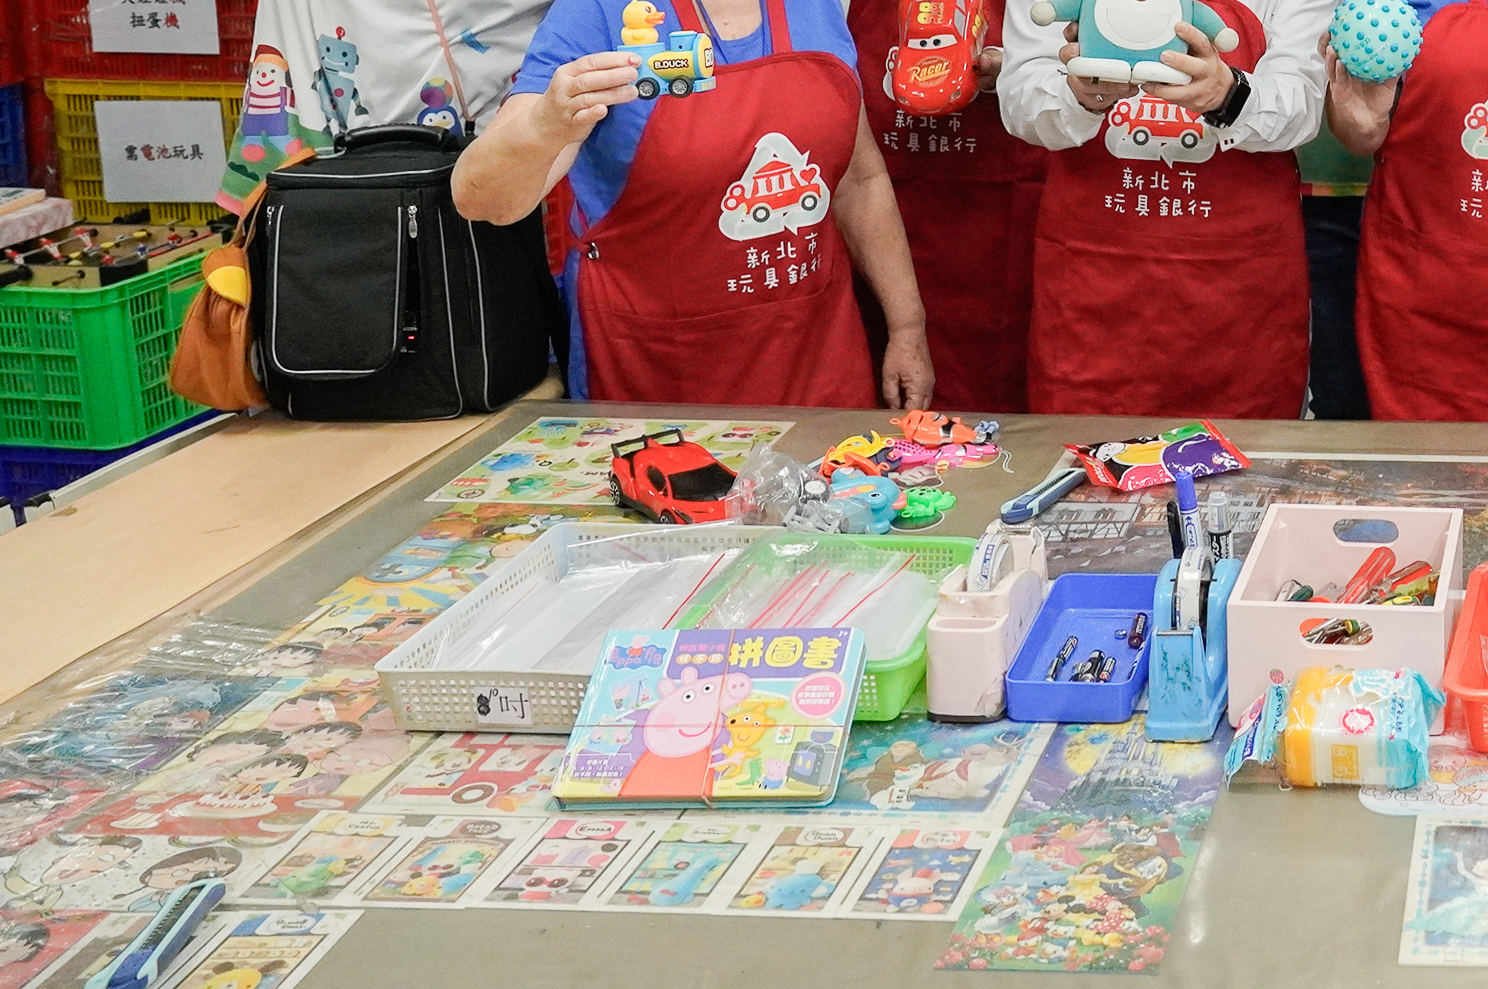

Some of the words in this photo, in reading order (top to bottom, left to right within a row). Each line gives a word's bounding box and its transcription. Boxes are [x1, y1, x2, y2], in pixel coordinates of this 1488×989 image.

[130, 11, 180, 30] 扭蛋機
[653, 58, 690, 70] B.DUCK
[907, 60, 951, 82] Racer
[895, 109, 962, 132] 新北市
[124, 143, 204, 161] 需電池玩具
[883, 131, 977, 154] 玩具銀行
[1121, 166, 1196, 195] 新北市
[1104, 193, 1213, 218] 玩具銀行
[745, 231, 819, 269] 新北市
[726, 256, 824, 294] 玩具銀行
[728, 635, 842, 670] 拼圖書
[499, 692, 529, 720] 吋
